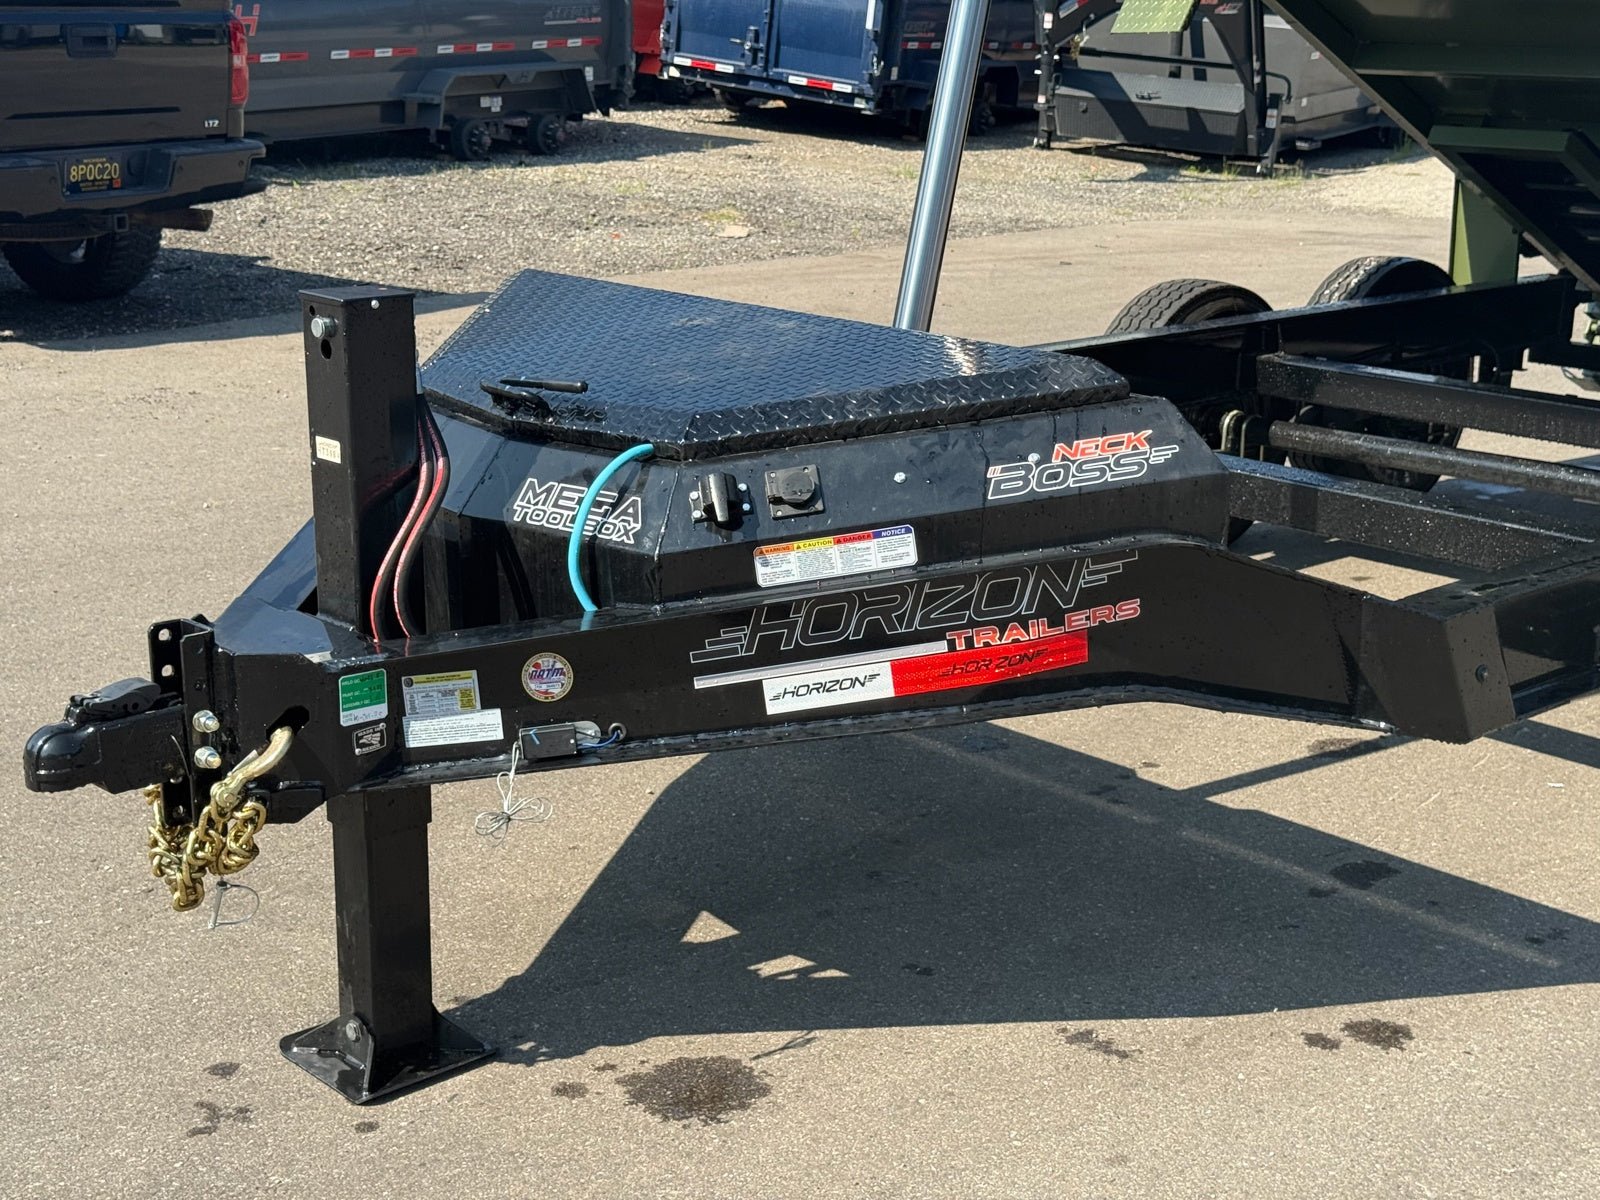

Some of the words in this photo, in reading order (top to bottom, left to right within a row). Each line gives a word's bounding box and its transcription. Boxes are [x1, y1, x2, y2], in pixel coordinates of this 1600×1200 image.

[1052, 430, 1153, 463] NECK
[988, 448, 1160, 499] BOSS
[803, 539, 833, 549] CAUTION
[842, 533, 872, 543] DANGER
[881, 528, 906, 537] NOTICE
[765, 545, 791, 553] WARNING
[720, 553, 1110, 656] HORIZON
[946, 599, 1141, 650] TRAILERS
[776, 674, 873, 699] HORIZON
